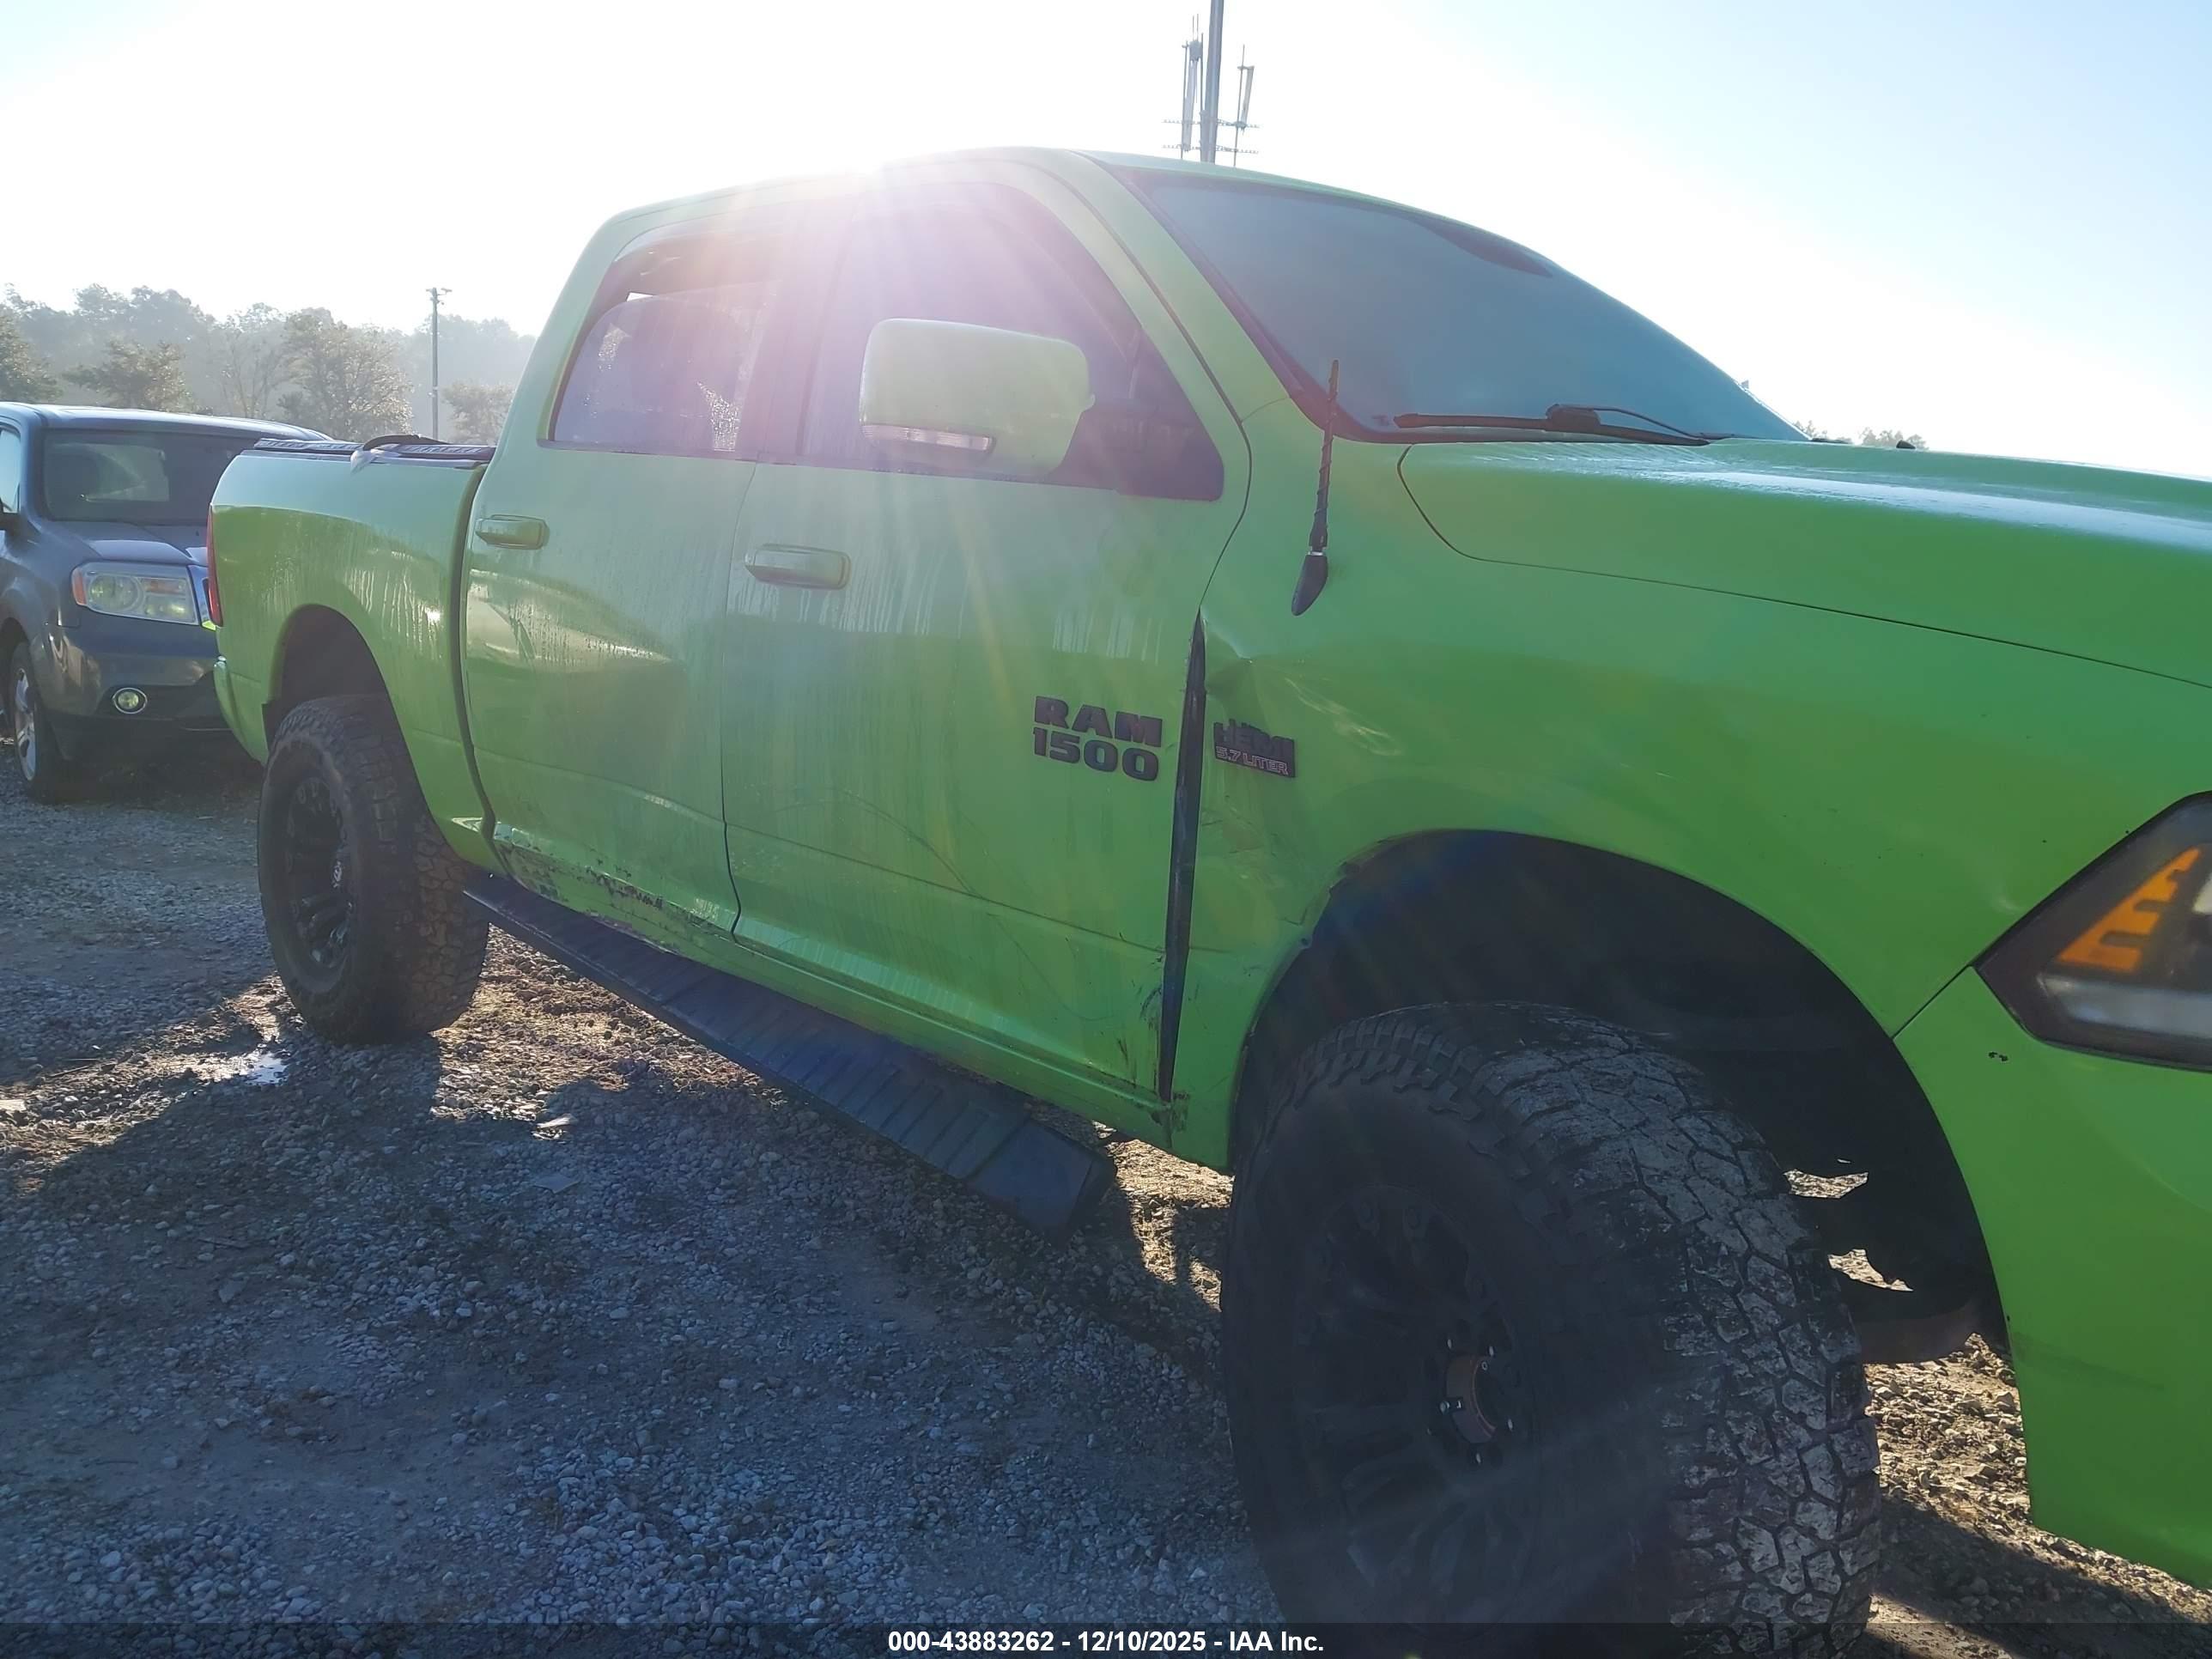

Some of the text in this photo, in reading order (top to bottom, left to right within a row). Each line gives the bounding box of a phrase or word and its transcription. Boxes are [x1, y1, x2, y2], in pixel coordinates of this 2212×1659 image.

[1034, 696, 1163, 748] RAM
[1033, 726, 1159, 782] 1500
[1215, 745, 1290, 775] 5.7 LITER
